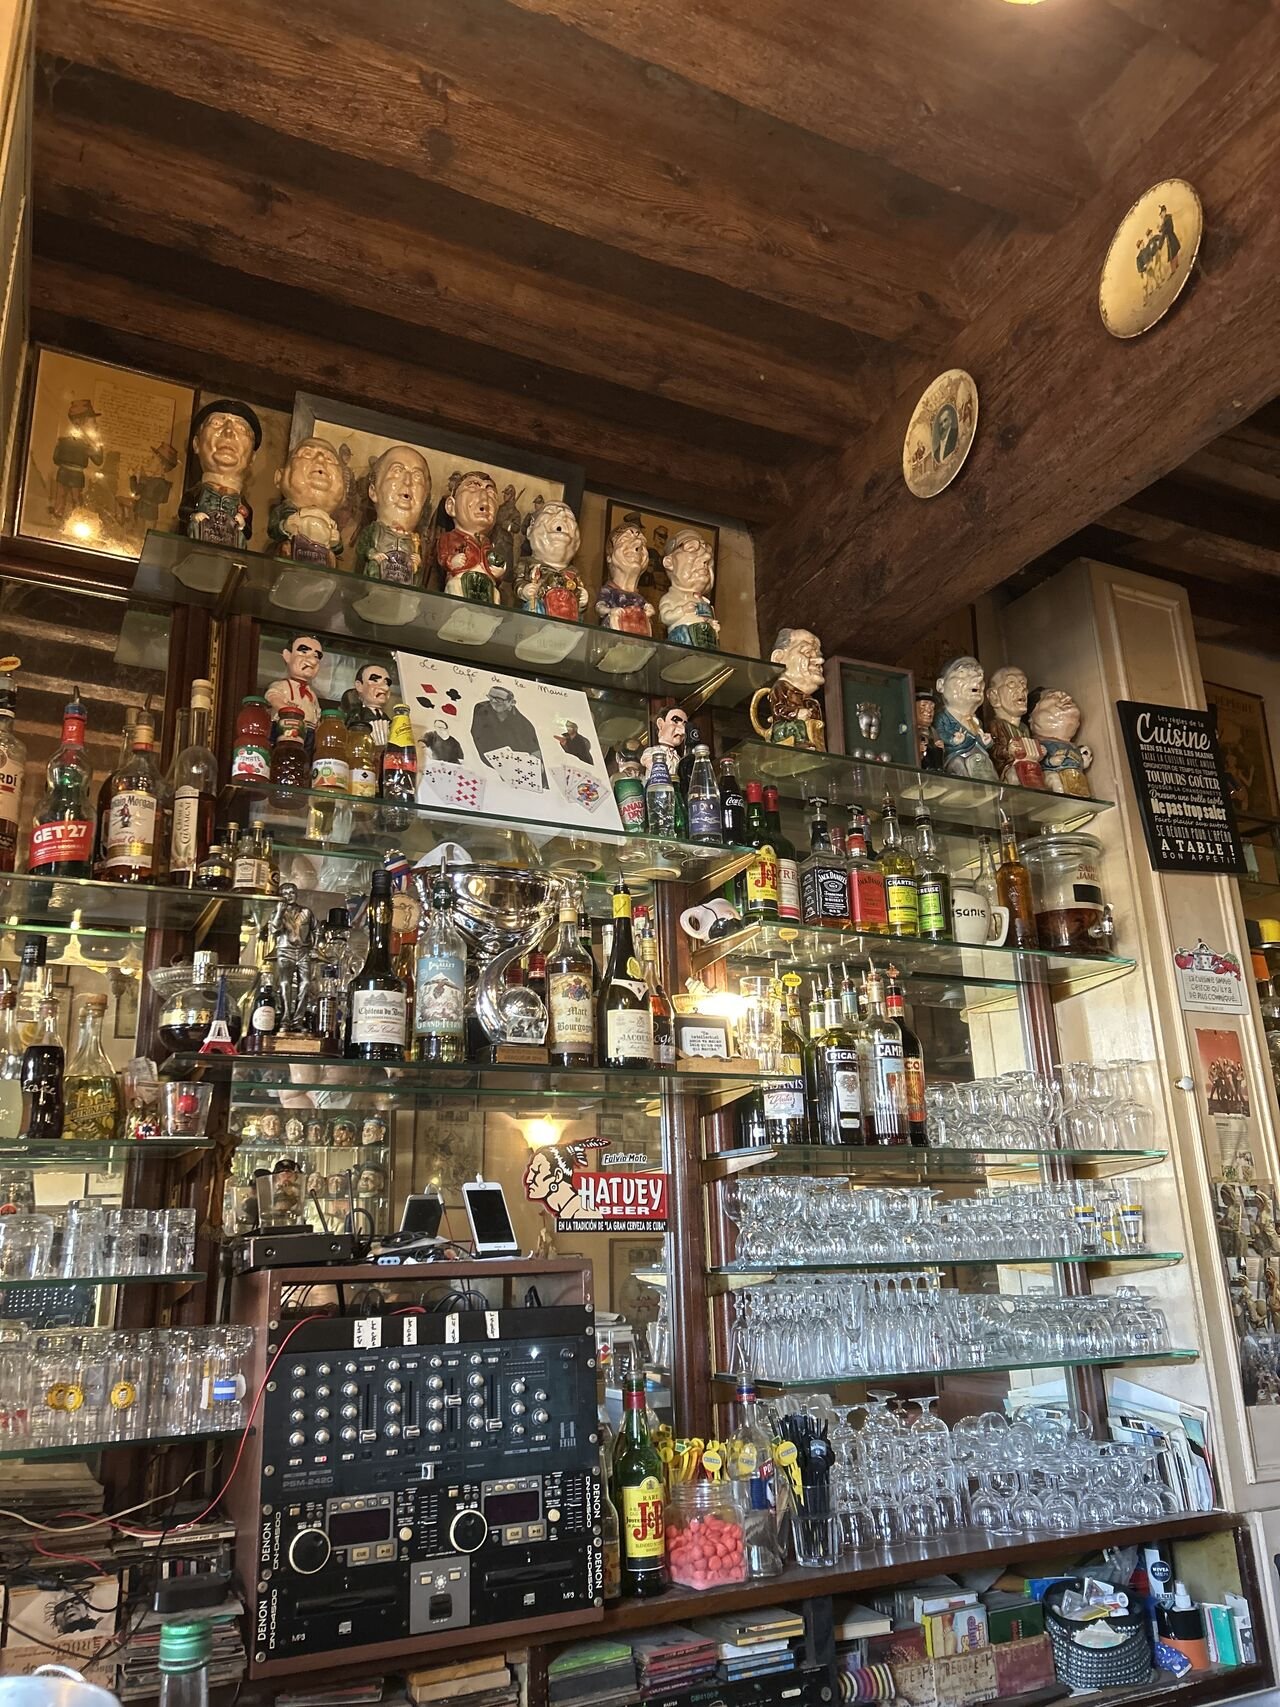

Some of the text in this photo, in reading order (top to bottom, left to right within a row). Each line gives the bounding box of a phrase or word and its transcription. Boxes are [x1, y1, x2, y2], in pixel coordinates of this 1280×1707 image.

[419, 659, 438, 671] Le
[453, 665, 478, 683] Café
[1136, 712, 1211, 751] Cuisine
[1140, 743, 1214, 760] BIEN SE LAVER LES MAINS
[1157, 753, 1164, 761] LA
[1165, 754, 1186, 764] CUISINE
[1145, 769, 1221, 791] TOUJOURS GOÛTER
[1151, 798, 1226, 821] Ne pas trop saler
[33, 825, 87, 844] GET 27
[1161, 838, 1235, 857] A TABLE !
[1162, 851, 1184, 860] BON
[577, 1176, 663, 1212] HATUEY
[598, 1206, 650, 1215] BEER
[558, 1221, 566, 1231] EN
[565, 1221, 572, 1231] LA
[572, 1219, 597, 1231] TRADICIÓN
[597, 1221, 604, 1230] DE
[612, 1221, 626, 1230] GRAN
[626, 1221, 646, 1230] CERVEZA
[646, 1221, 653, 1230] DE
[585, 1475, 593, 1528] DN-D4500
[591, 1483, 601, 1519] DENON
[261, 1522, 272, 1562] DENON
[273, 1511, 281, 1570] DN-D4500
[594, 1552, 604, 1590] DENON
[563, 1591, 575, 1600] MP3
[257, 1600, 268, 1641] DENON
[269, 1588, 278, 1650] DN-D4500
[291, 1633, 306, 1642] MP3
